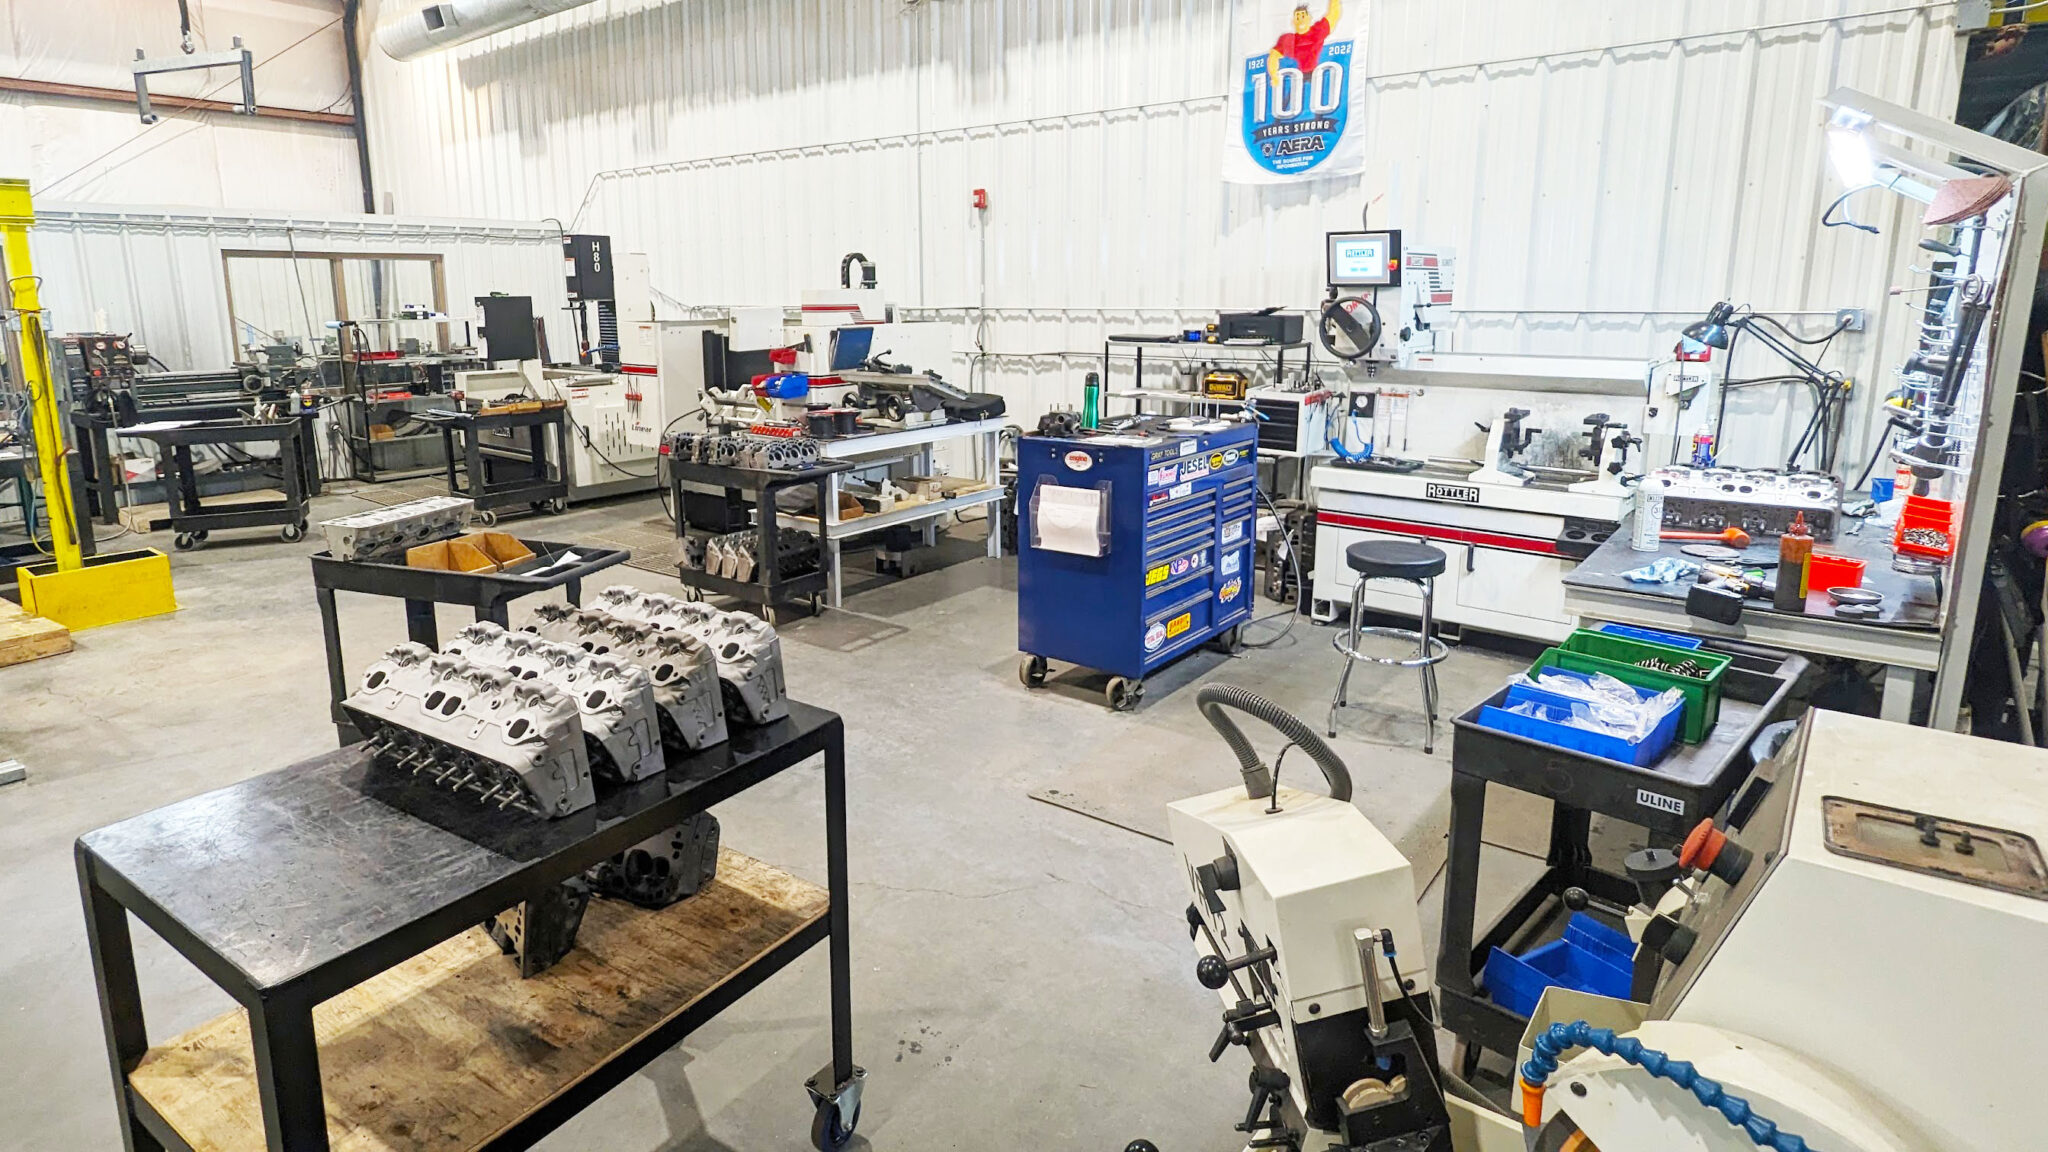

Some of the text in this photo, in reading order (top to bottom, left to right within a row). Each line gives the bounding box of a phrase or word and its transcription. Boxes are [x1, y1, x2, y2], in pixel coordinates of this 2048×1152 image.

[1328, 44, 1352, 56] 2022
[1248, 58, 1265, 70] 1922
[1251, 61, 1344, 123] 100
[1262, 120, 1330, 137] YEARS STRONG
[1276, 135, 1325, 155] AERA
[591, 241, 601, 273] H80
[1209, 382, 1233, 393] DEWALT
[1180, 457, 1207, 474] JESEL
[1427, 483, 1479, 502] ROTTLER
[1146, 566, 1169, 586] JEGS
[1640, 792, 1681, 812] ULINE
